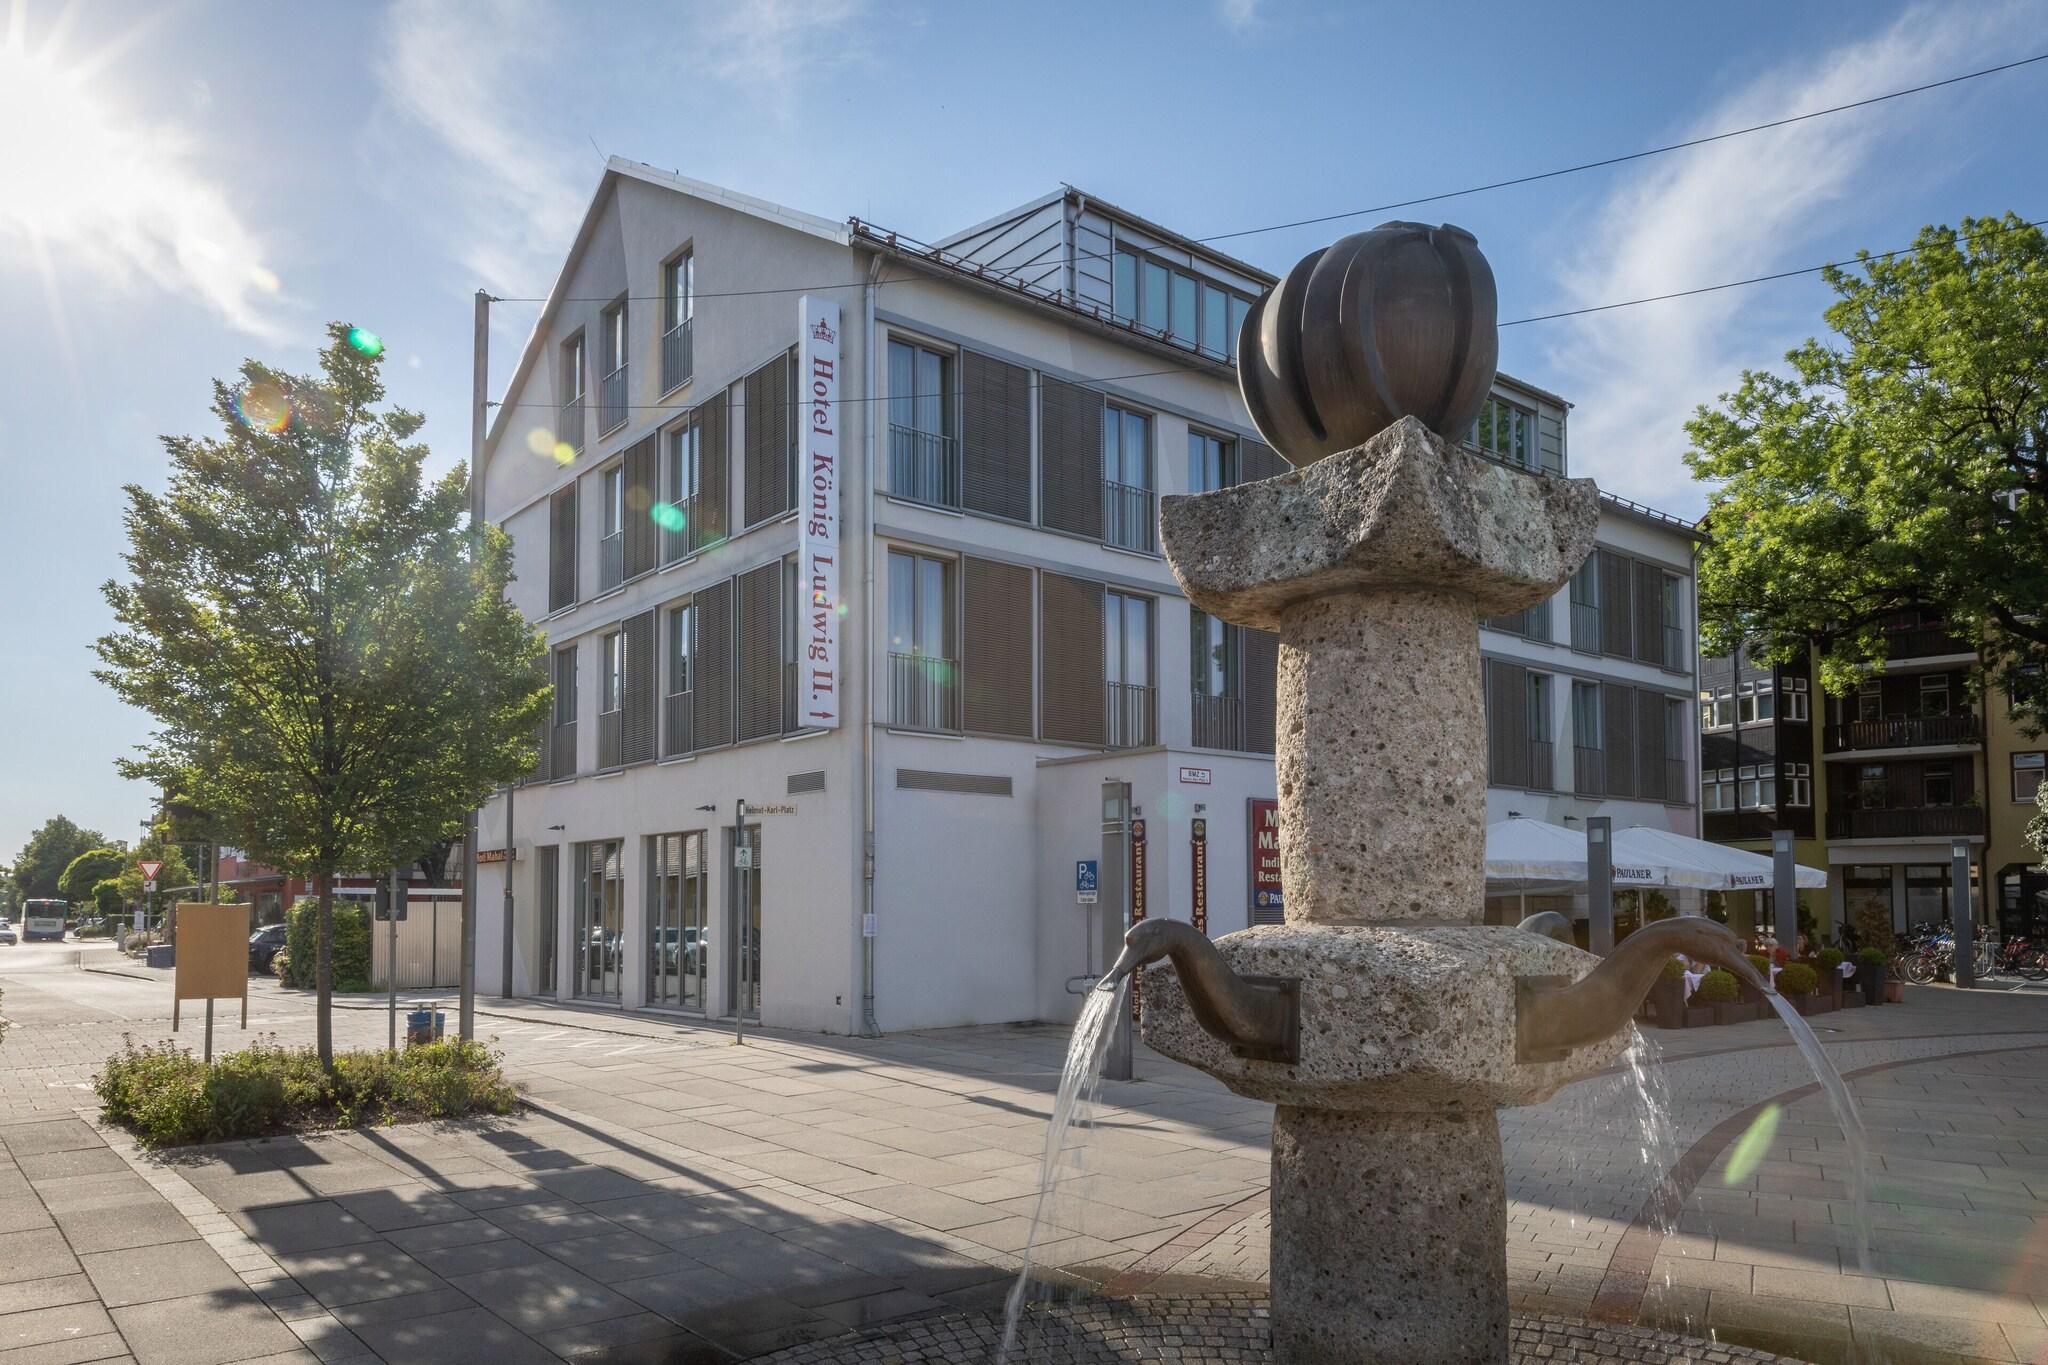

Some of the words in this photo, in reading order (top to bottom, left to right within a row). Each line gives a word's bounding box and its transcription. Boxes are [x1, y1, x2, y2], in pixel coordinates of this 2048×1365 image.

[813, 355, 833, 436] Hotel
[808, 451, 834, 539] König
[808, 552, 833, 662] Ludwig
[812, 667, 833, 700] II.
[745, 805, 795, 814] Helmut-Karl-Platz
[1079, 863, 1088, 879] P
[1134, 841, 1143, 916] Restaurant
[1195, 841, 1204, 916] Restaurant
[1616, 867, 1653, 879] PAULANER
